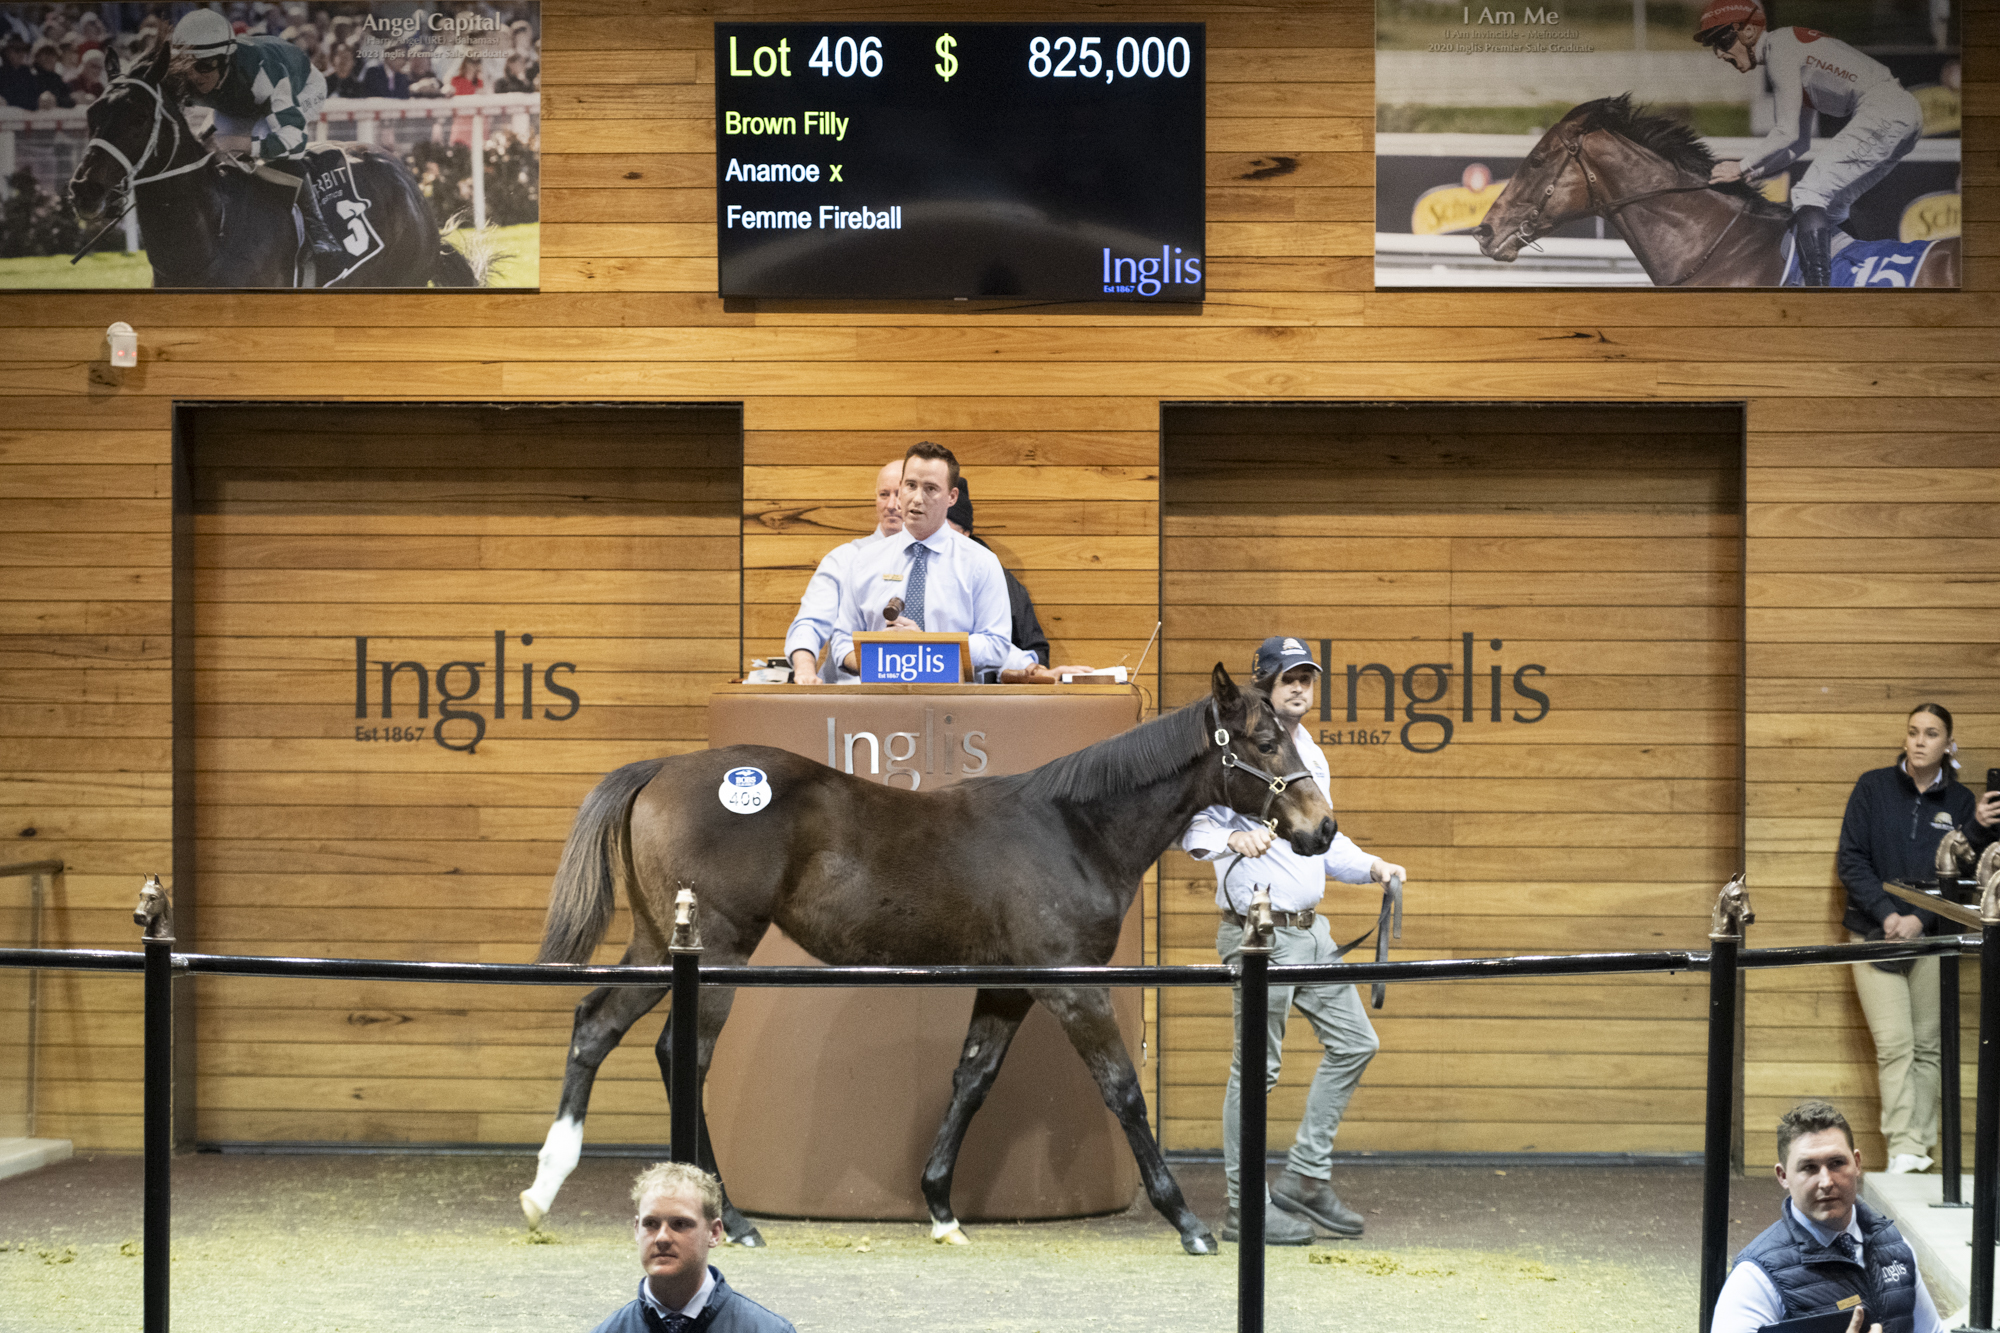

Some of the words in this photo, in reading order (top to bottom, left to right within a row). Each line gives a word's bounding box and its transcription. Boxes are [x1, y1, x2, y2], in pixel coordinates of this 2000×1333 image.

[362, 11, 421, 37] Angel
[427, 11, 501, 37] Capital
[1463, 6, 1469, 25] I
[1477, 6, 1516, 25] Am
[1523, 6, 1560, 25] Me
[1472, 29, 1519, 39] Invincible
[355, 49, 379, 59] 2023
[380, 49, 405, 60] Inglis
[729, 36, 792, 78] Lot
[808, 35, 884, 78] 406
[934, 32, 959, 83] $
[1027, 36, 1191, 84] 825,000
[1428, 43, 1454, 53] 2020
[1456, 42, 1483, 55] Inglis
[1485, 42, 1523, 53] Premier
[1525, 43, 1547, 53] Sale
[1548, 42, 1595, 53] Graduate
[725, 111, 797, 136] Brown
[804, 111, 850, 141] Filly
[311, 166, 346, 199] RBIT
[725, 158, 820, 183] Anamoe
[828, 164, 844, 182] x
[335, 199, 370, 257] 3
[726, 204, 812, 230] Femme
[819, 205, 902, 230] Fireball
[1103, 244, 1202, 297] Inglis
[1103, 285, 1115, 293] Est
[1116, 285, 1136, 293] 1867
[878, 645, 945, 681] Inglis
[354, 630, 581, 752] Inglis
[1319, 632, 1551, 754] Inglis
[355, 725, 378, 742] Est
[382, 726, 426, 742] 1867
[1319, 729, 1343, 745] Est
[1349, 729, 1392, 745] 1867
[826, 708, 989, 792] Inglis
[729, 791, 762, 807] 406
[1881, 1260, 1907, 1282] nglis
